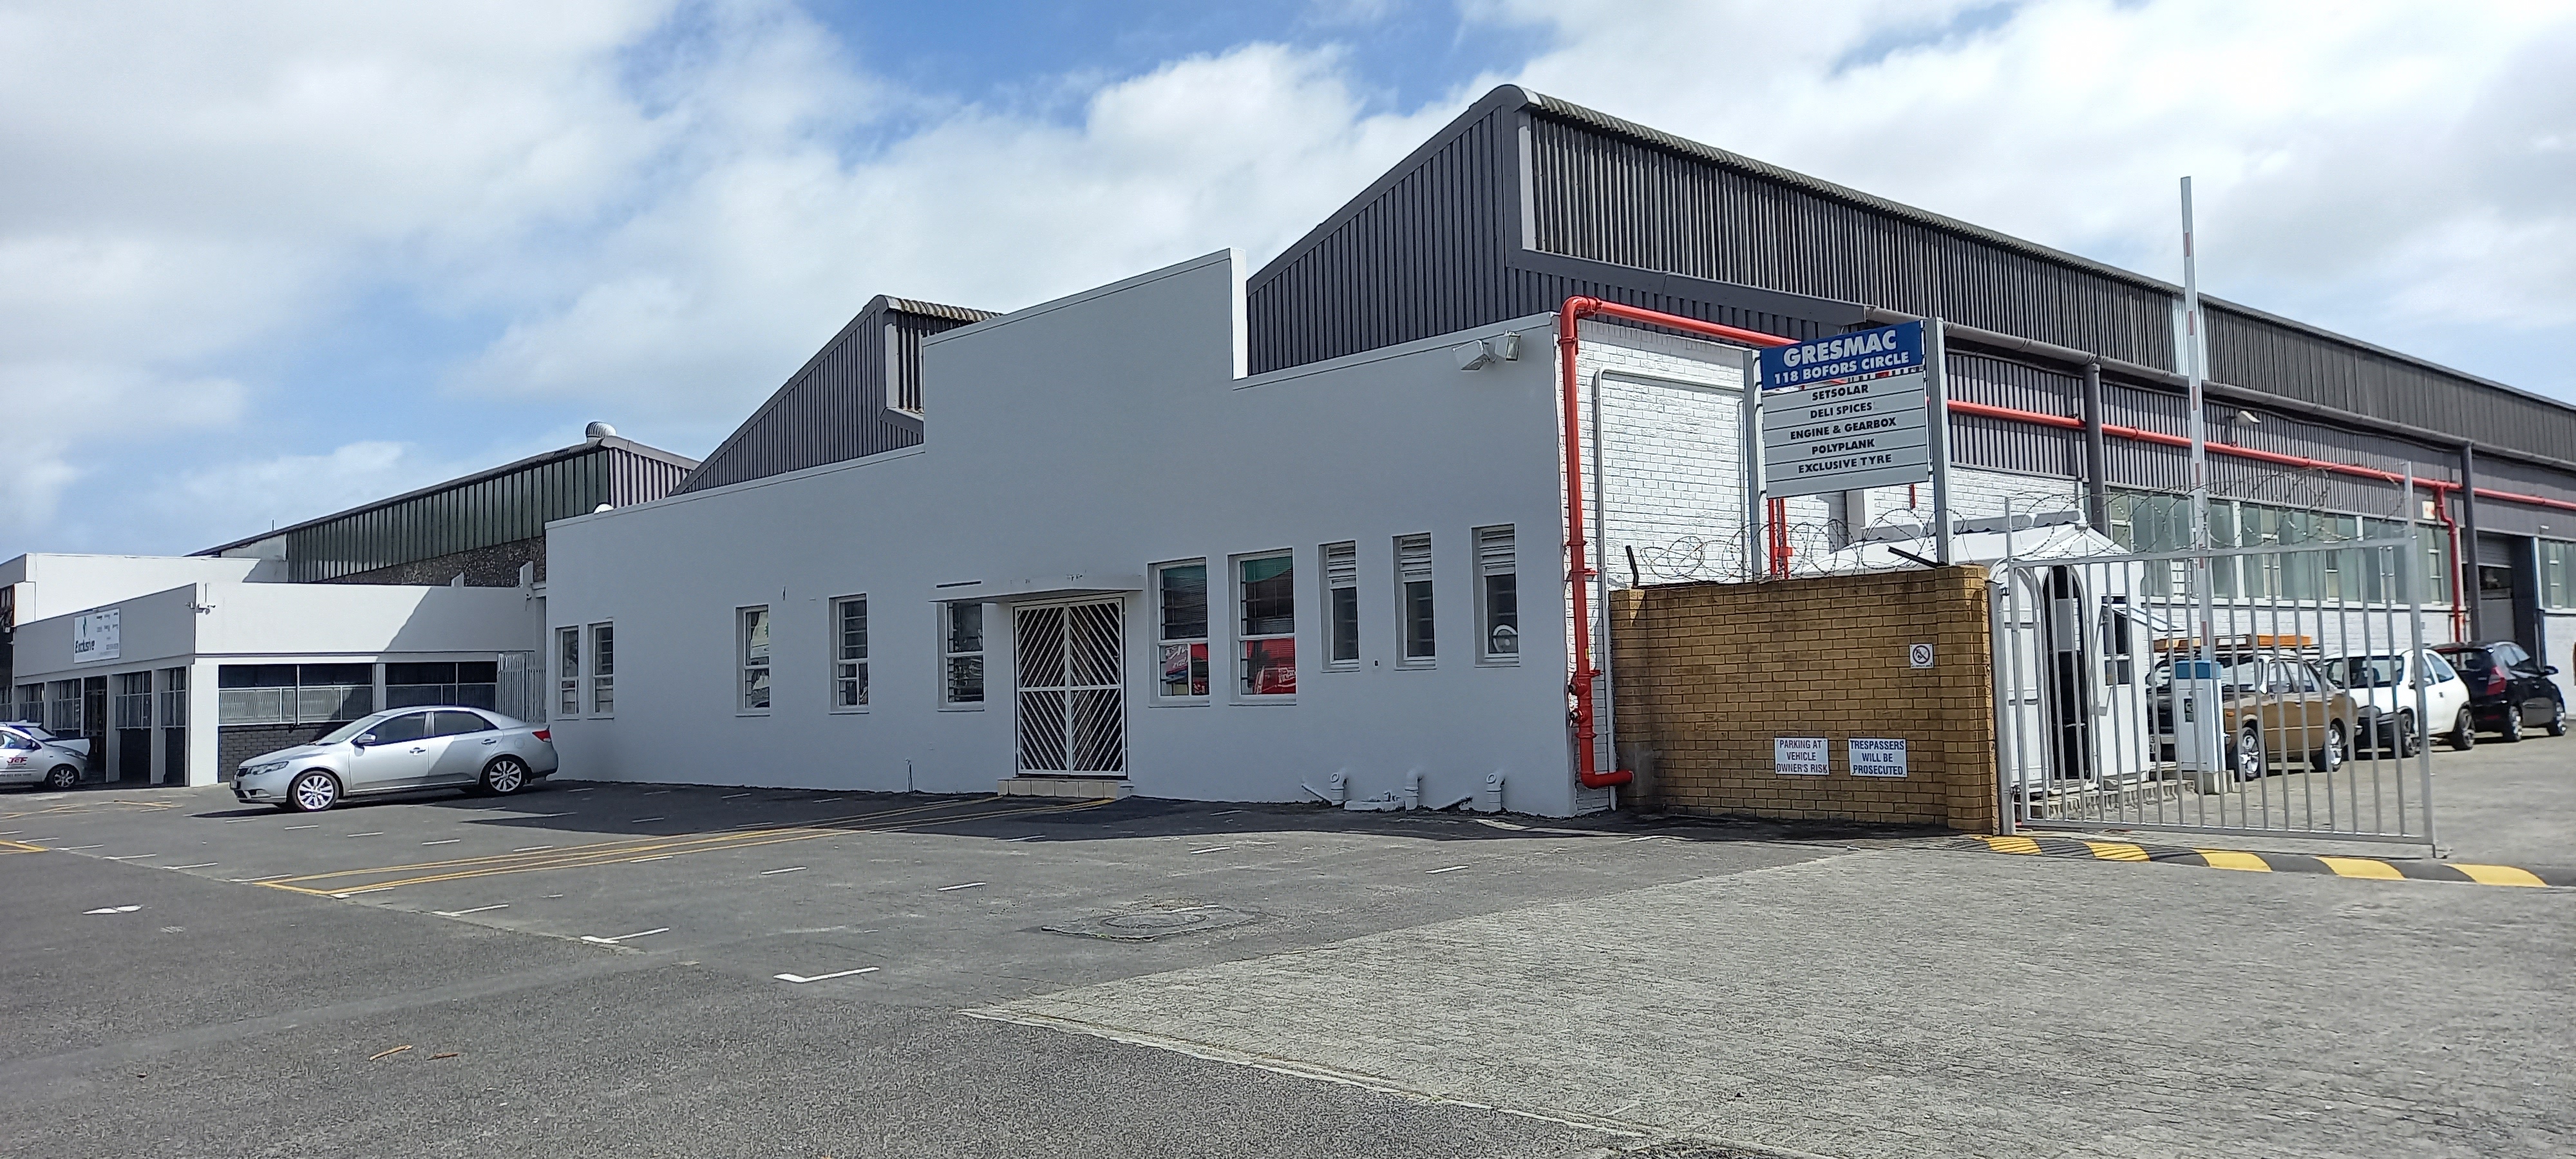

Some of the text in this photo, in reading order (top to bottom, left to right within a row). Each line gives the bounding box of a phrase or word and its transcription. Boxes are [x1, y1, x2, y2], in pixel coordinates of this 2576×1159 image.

[1783, 330, 1897, 367] GRESMAC
[1774, 352, 1909, 384] 118 BOFORS CIRCLE
[1812, 384, 1869, 400] SETSOLAR
[1810, 402, 1872, 419] DELI SPICES
[1790, 417, 1897, 440] ENGINE & GEARBOX
[1812, 438, 1875, 455] POLYPLANK
[1798, 454, 1891, 473] EXCLUSIVE TYRE
[1779, 740, 1822, 749] PARKING AT
[1850, 740, 1904, 750] TRESPASSERS
[1786, 751, 1817, 761] VEHICLE
[1862, 753, 1893, 762] WILL BE
[1776, 763, 1828, 773] OWNER'S RISK
[1853, 764, 1903, 775] PROSECUTED
